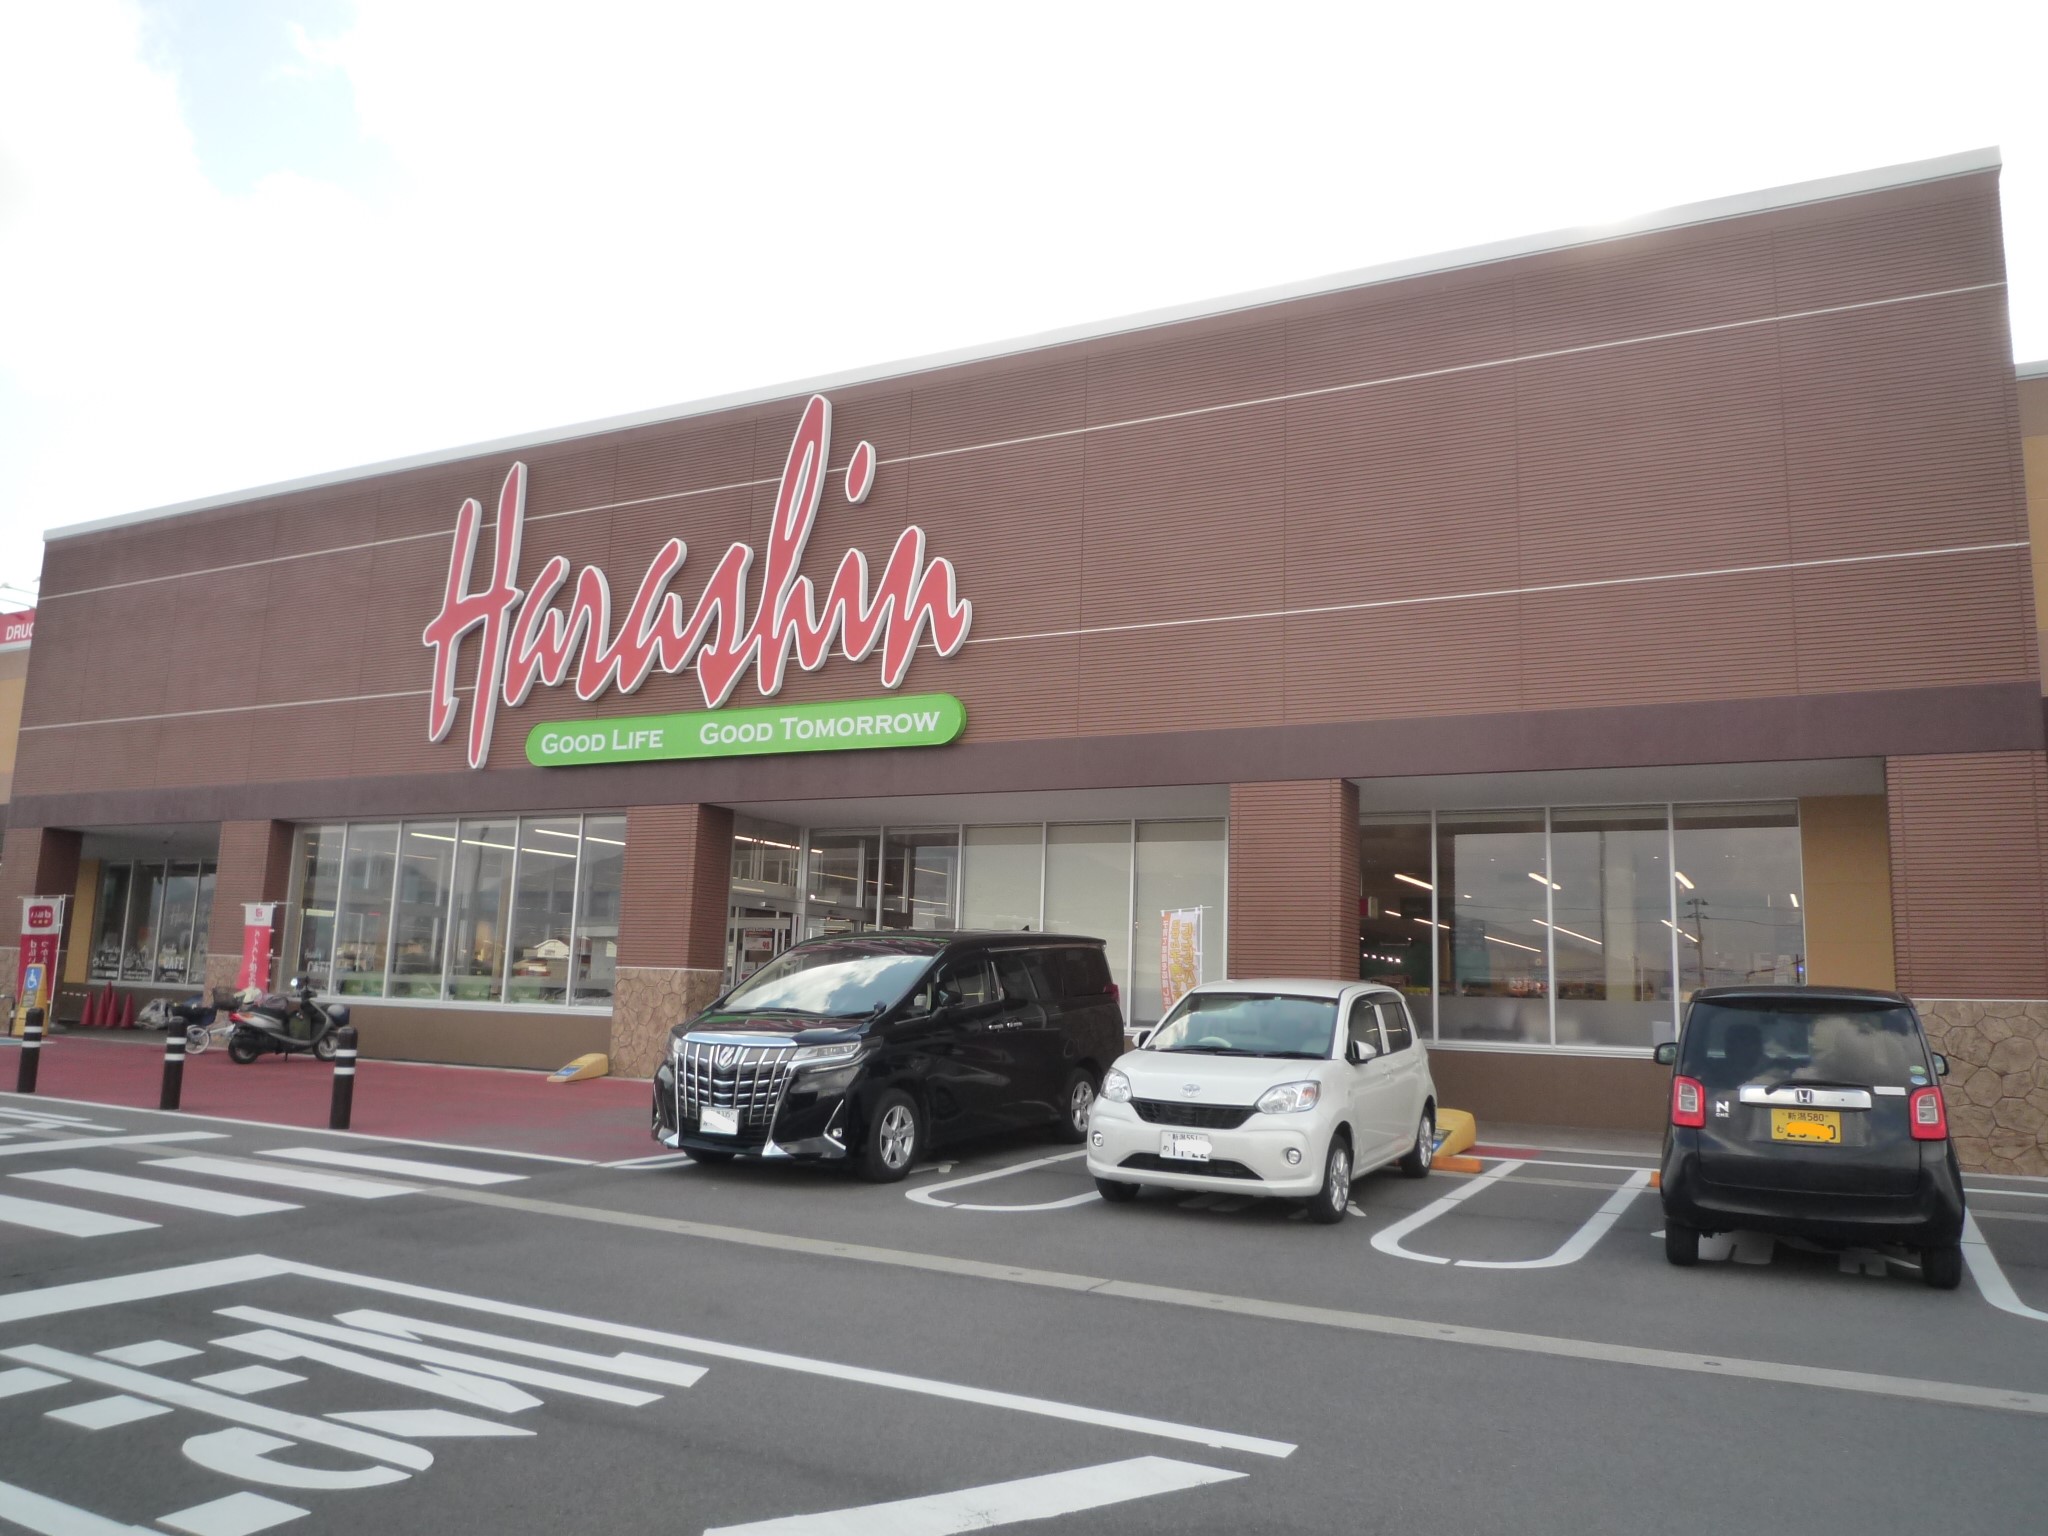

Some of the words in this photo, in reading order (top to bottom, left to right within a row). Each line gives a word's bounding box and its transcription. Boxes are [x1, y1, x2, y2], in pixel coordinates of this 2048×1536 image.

[423, 394, 972, 770] Harashin
[541, 732, 605, 755] GOOD
[611, 728, 663, 751] LIFE
[699, 721, 774, 746] GOOD
[779, 711, 941, 742] TOMORROW
[1787, 1112, 1825, 1122] 新潟580
